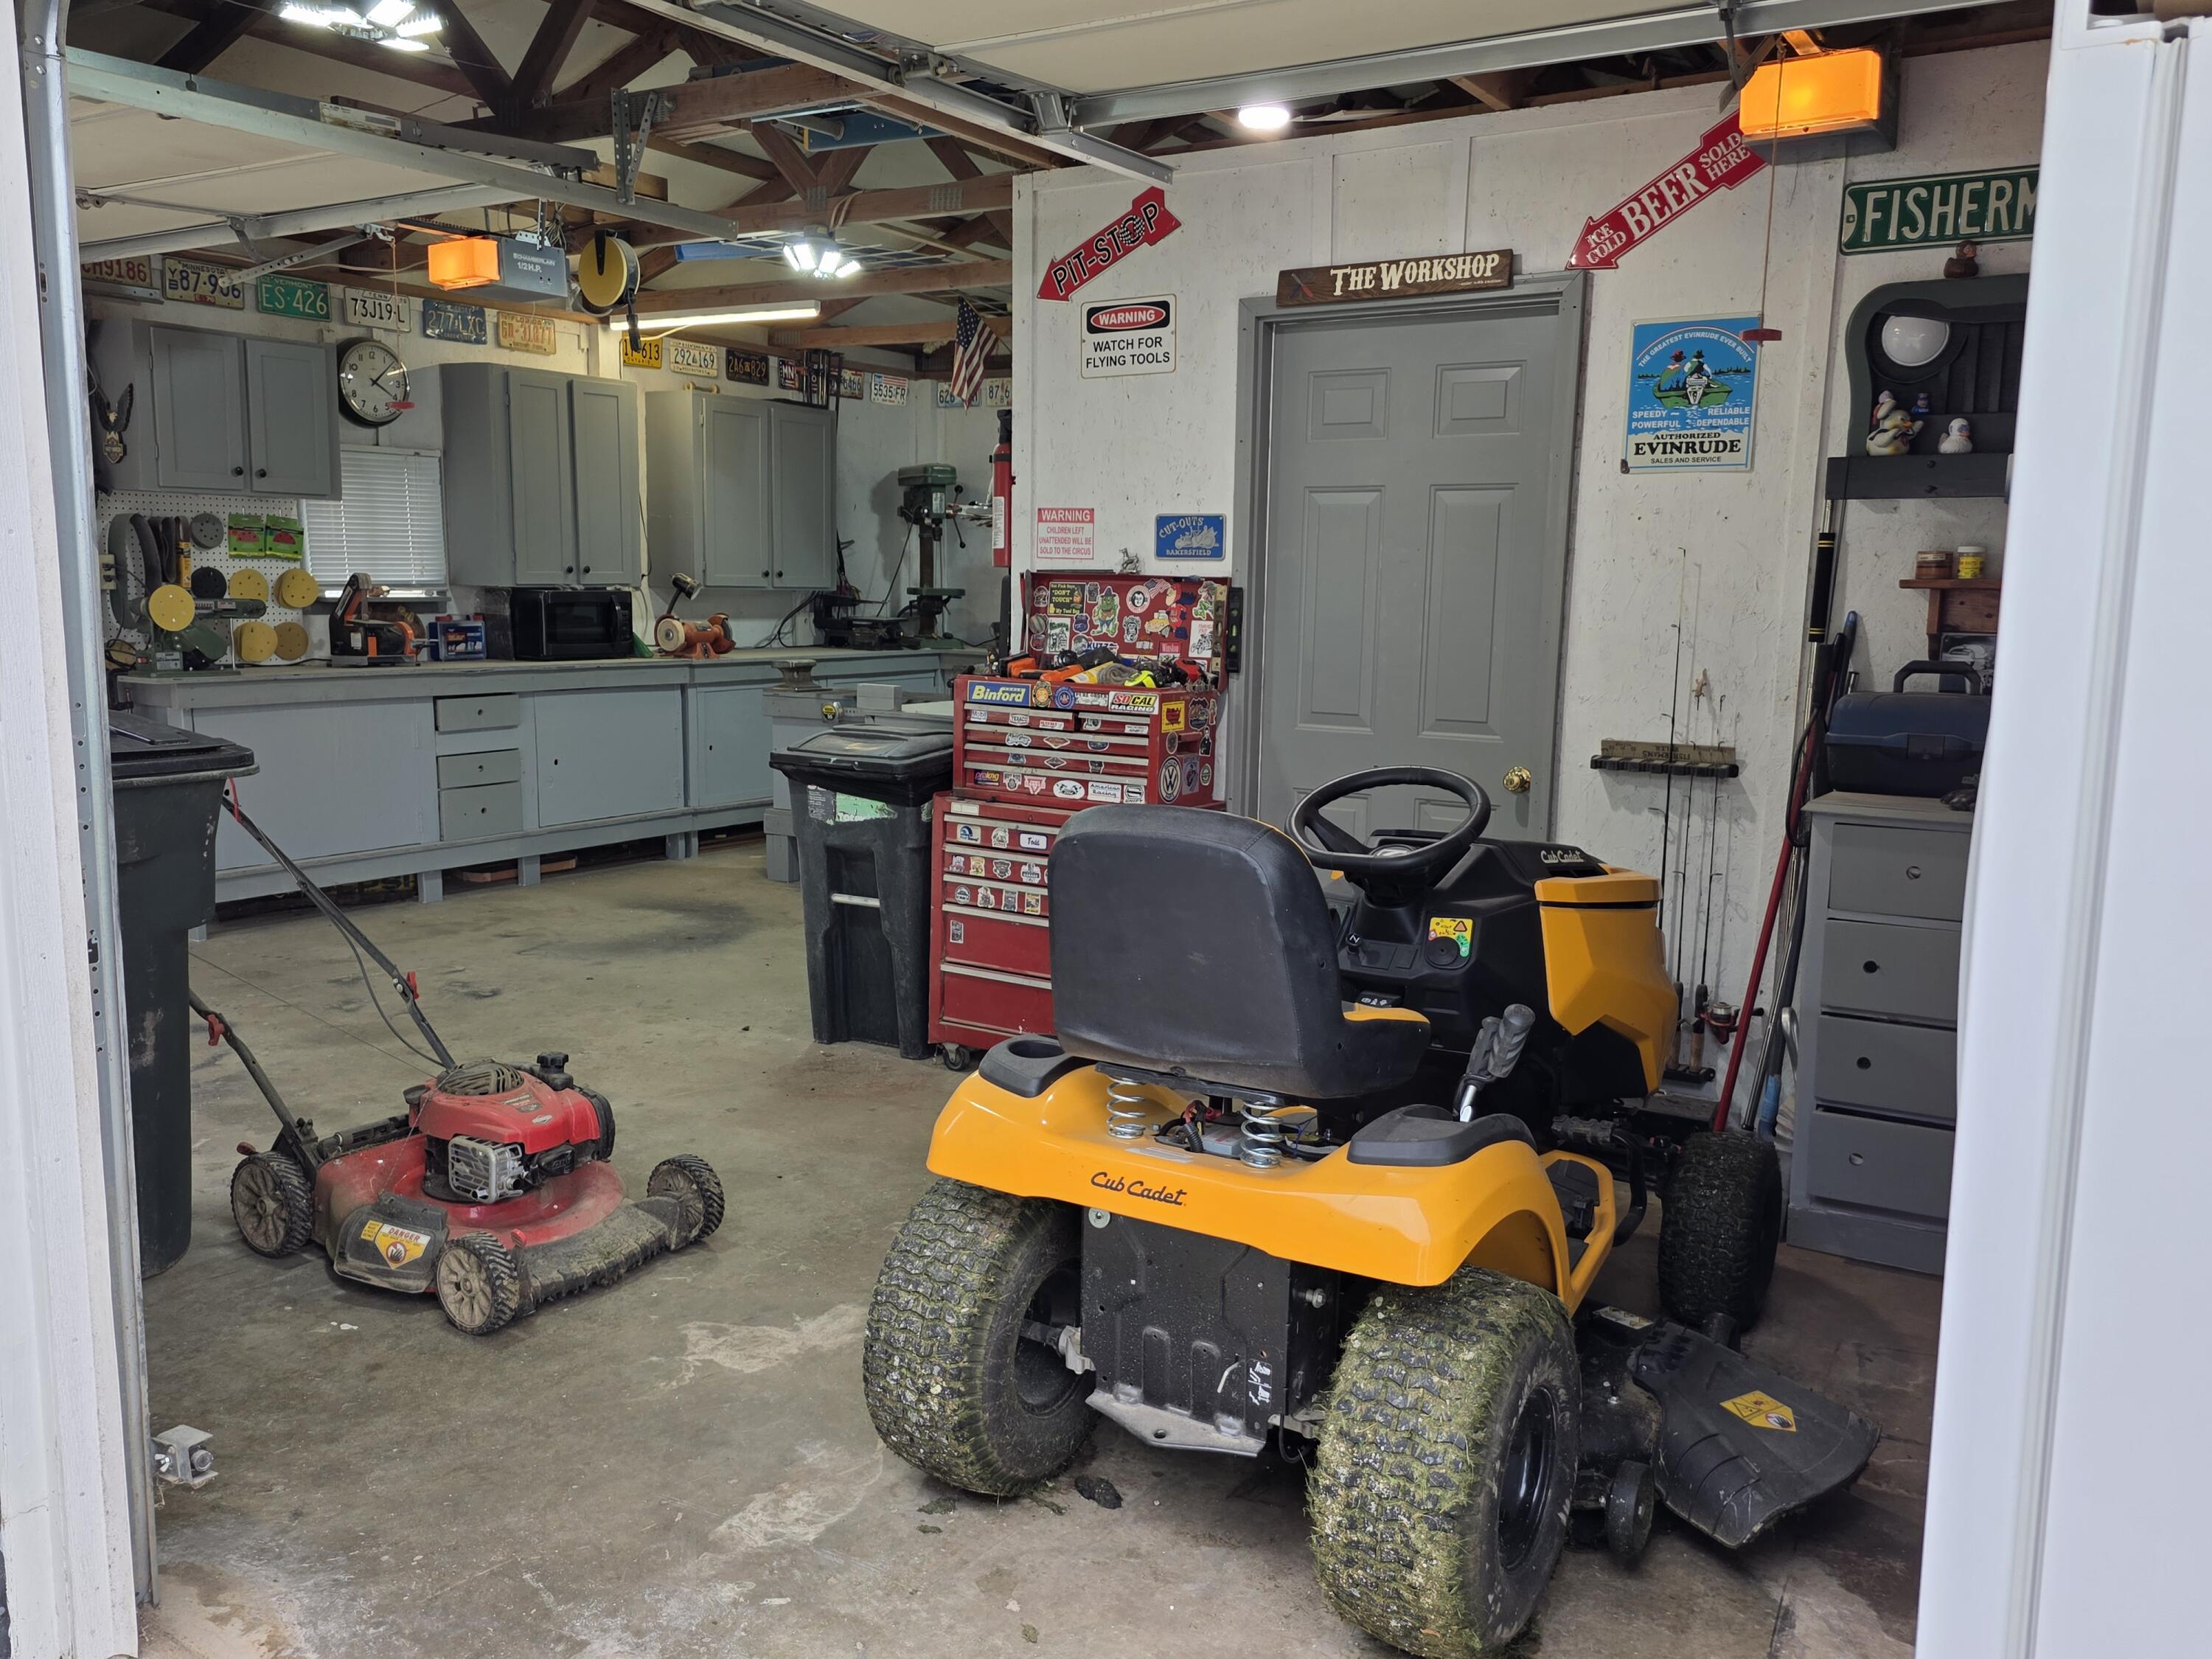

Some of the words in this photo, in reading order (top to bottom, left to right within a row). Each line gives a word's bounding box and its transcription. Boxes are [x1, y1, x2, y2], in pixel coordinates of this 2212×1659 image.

[1699, 132, 1741, 168] SOLD
[1705, 144, 1750, 181] HERE
[1619, 162, 1709, 240] BEER
[1585, 223, 1613, 248] ICE
[1052, 201, 1159, 295] PIT-STOP
[1586, 231, 1627, 264] COLD
[182, 262, 225, 275] MINNESOTA
[1330, 266, 1377, 296] THE
[1380, 254, 1499, 291] WORKSHOP
[275, 277, 313, 289] VERMONT
[1099, 310, 1155, 326] WARNING
[1093, 338, 1134, 352] WATCH
[1138, 336, 1162, 349] FOR
[1638, 355, 1650, 367] THE
[1650, 334, 1683, 355] GREATEST
[1684, 332, 1719, 340] EVINRUDE
[1719, 335, 1737, 349] EVER
[1736, 346, 1752, 363] BUILT
[369, 351, 375, 360] 12
[674, 347, 692, 366] 292
[699, 351, 714, 368] 169
[1086, 354, 1126, 369] FLYING
[1130, 352, 1170, 365] TOOLS
[373, 405, 378, 413] 6
[1632, 410, 1667, 418] SPEEDY
[1708, 407, 1750, 415] RELIABLE
[1632, 420, 1680, 428] POWERFUL
[1697, 417, 1749, 426] DEPENDABLE
[1653, 432, 1721, 440] AUTHORIZED
[1634, 439, 1741, 456] EVINRUDE
[1041, 509, 1091, 521] WARNING
[1047, 526, 1071, 534] CHILDREN
[1072, 526, 1084, 535] LEFT
[1159, 517, 1203, 538] CUT-OUTS
[1072, 537, 1083, 545] WILL
[972, 685, 1026, 703] Binford
[1113, 694, 1131, 704] SO
[1132, 696, 1153, 706] CAL
[1091, 783, 1120, 791] American
[1093, 790, 1116, 798] Racing
[1027, 838, 1040, 846] Todd
[1541, 849, 1559, 863] Cub
[1557, 849, 1584, 862] Cadet
[1091, 1172, 1124, 1192] Cub
[1127, 1180, 1187, 1206] Cadet
[389, 1228, 421, 1242] DANGER
